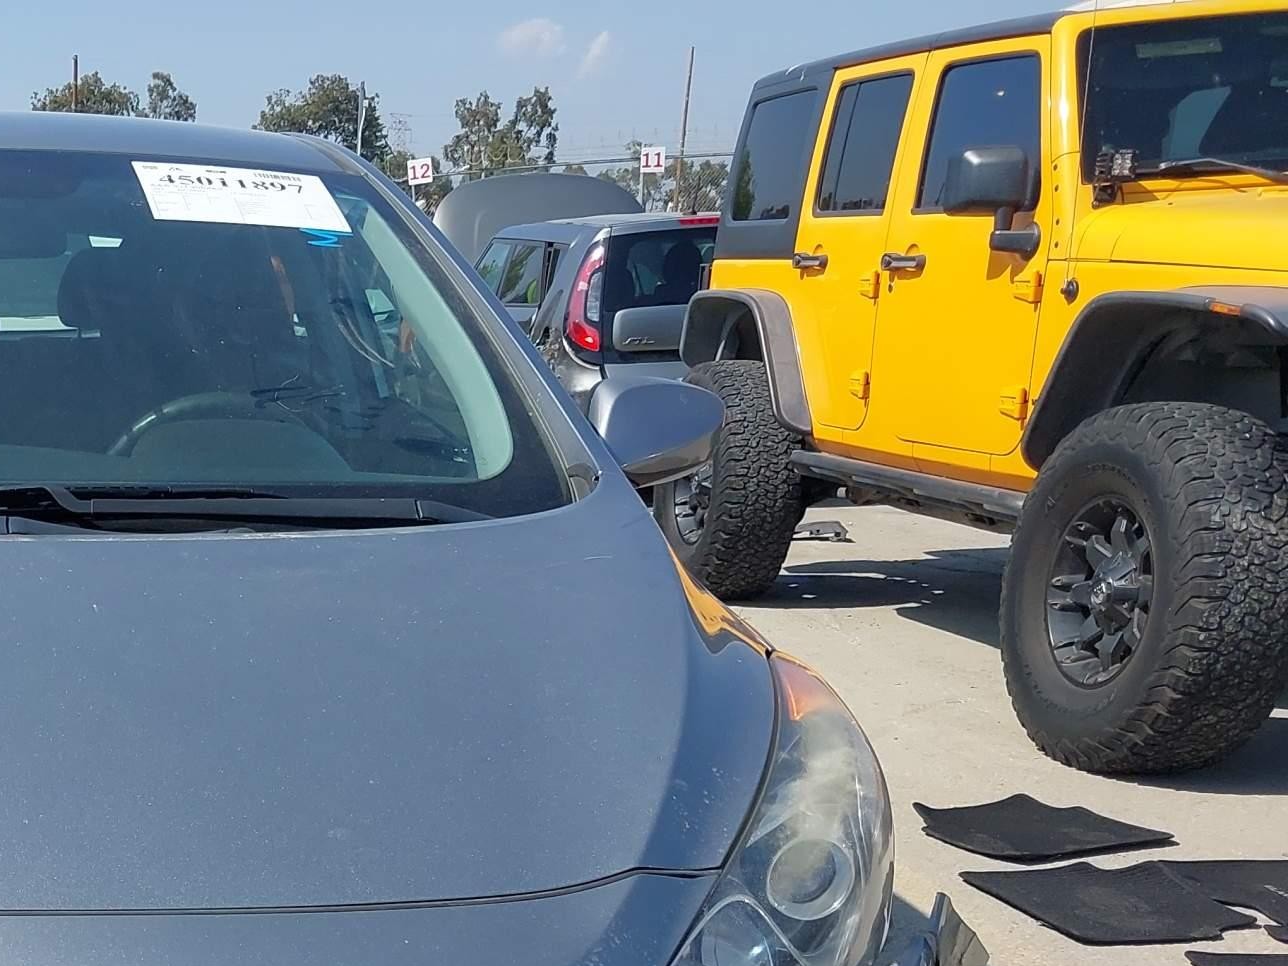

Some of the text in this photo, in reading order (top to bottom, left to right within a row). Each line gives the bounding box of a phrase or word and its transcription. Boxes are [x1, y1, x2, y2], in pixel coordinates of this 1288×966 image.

[641, 151, 664, 168] 11
[409, 163, 431, 180] 12
[159, 174, 303, 194] 45011897
